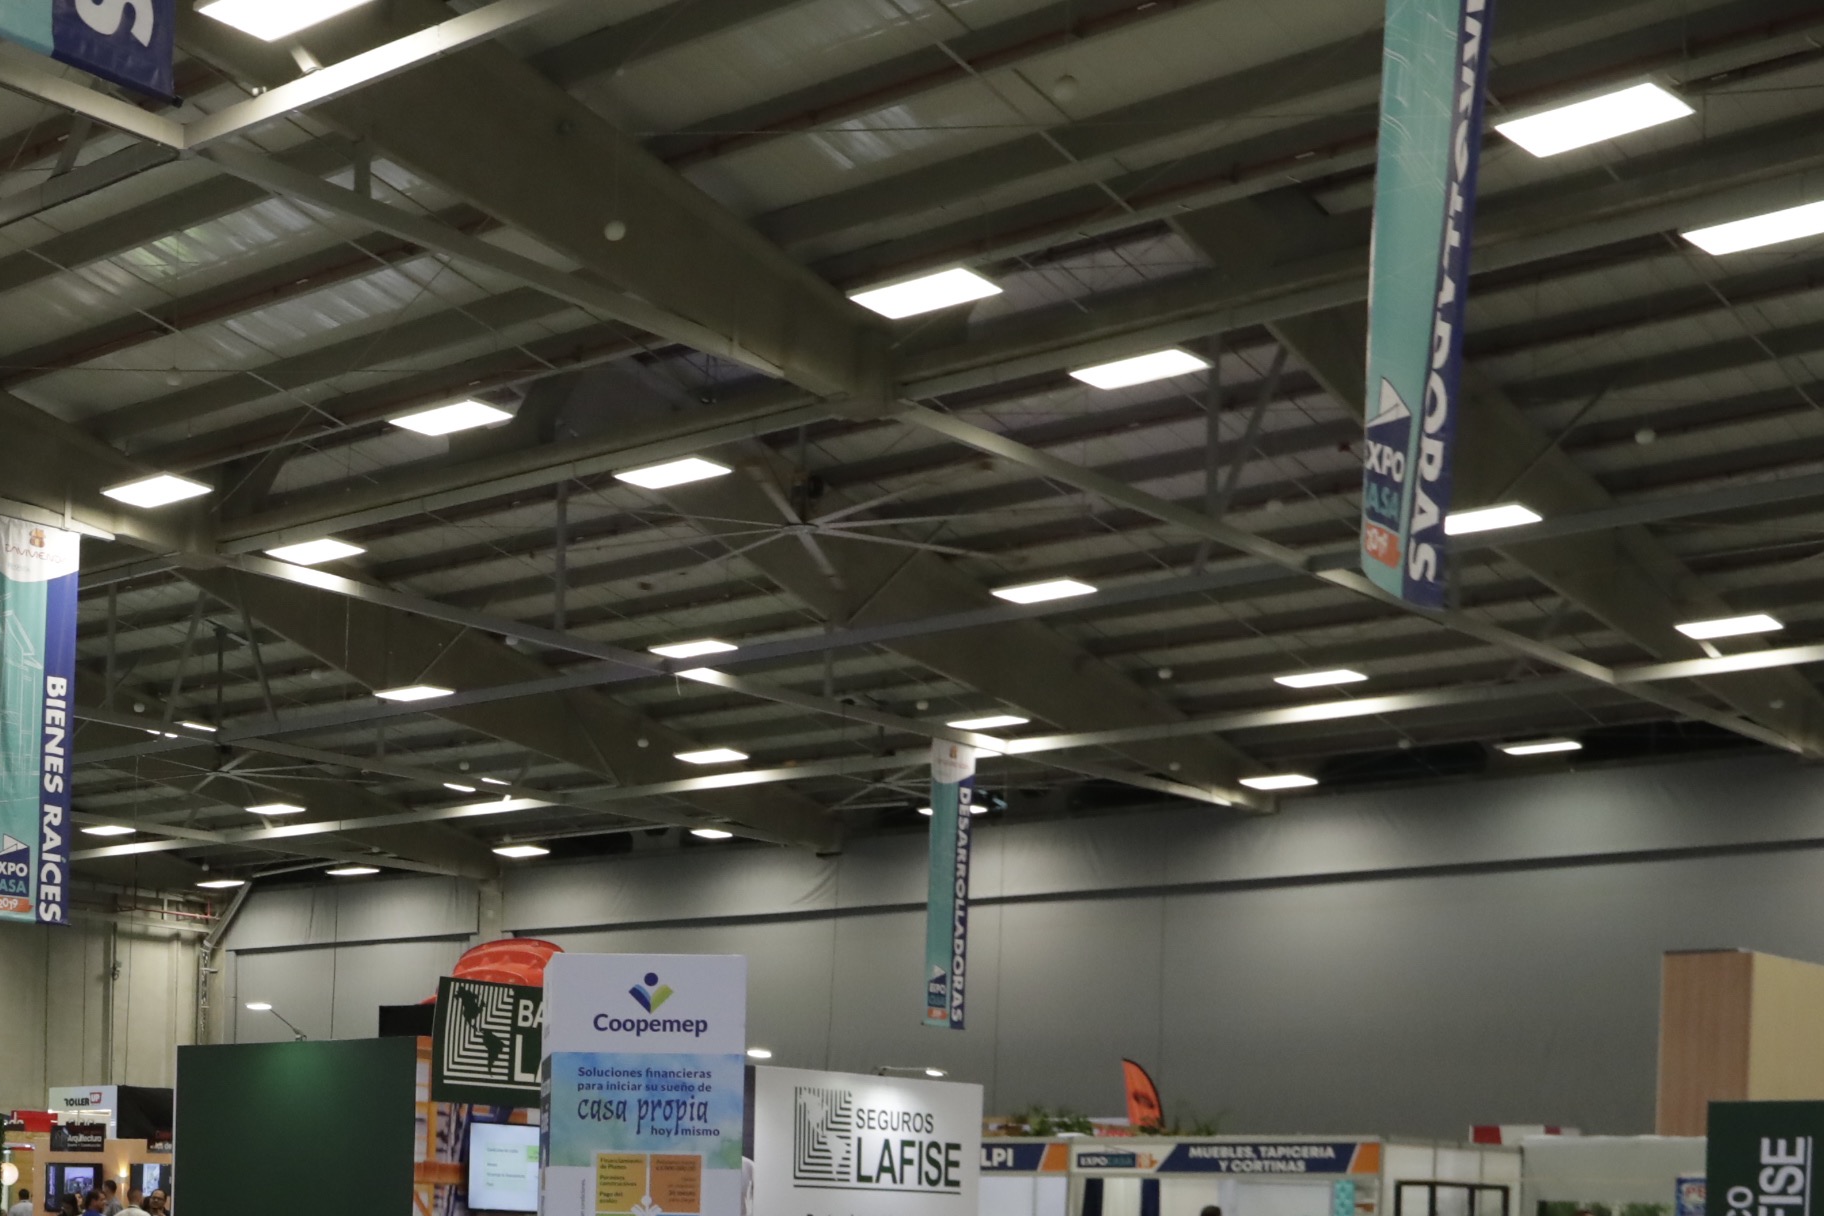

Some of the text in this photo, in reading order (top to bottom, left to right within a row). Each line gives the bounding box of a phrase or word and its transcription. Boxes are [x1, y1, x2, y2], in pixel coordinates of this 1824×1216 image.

[1365, 440, 1405, 482] XPO
[39, 675, 67, 922] BIENES RAÍCES
[593, 1013, 708, 1037] Coopemep
[578, 1067, 712, 1079] Soluciones financieras
[577, 1081, 712, 1092] para iniciar su sueño de
[577, 1095, 709, 1135] casa propia
[856, 1107, 934, 1134] SEGUROS
[651, 1125, 720, 1138] hoy mismo
[856, 1137, 961, 1188] LAFISE
[1230, 1160, 1306, 1172] CORTINAS
